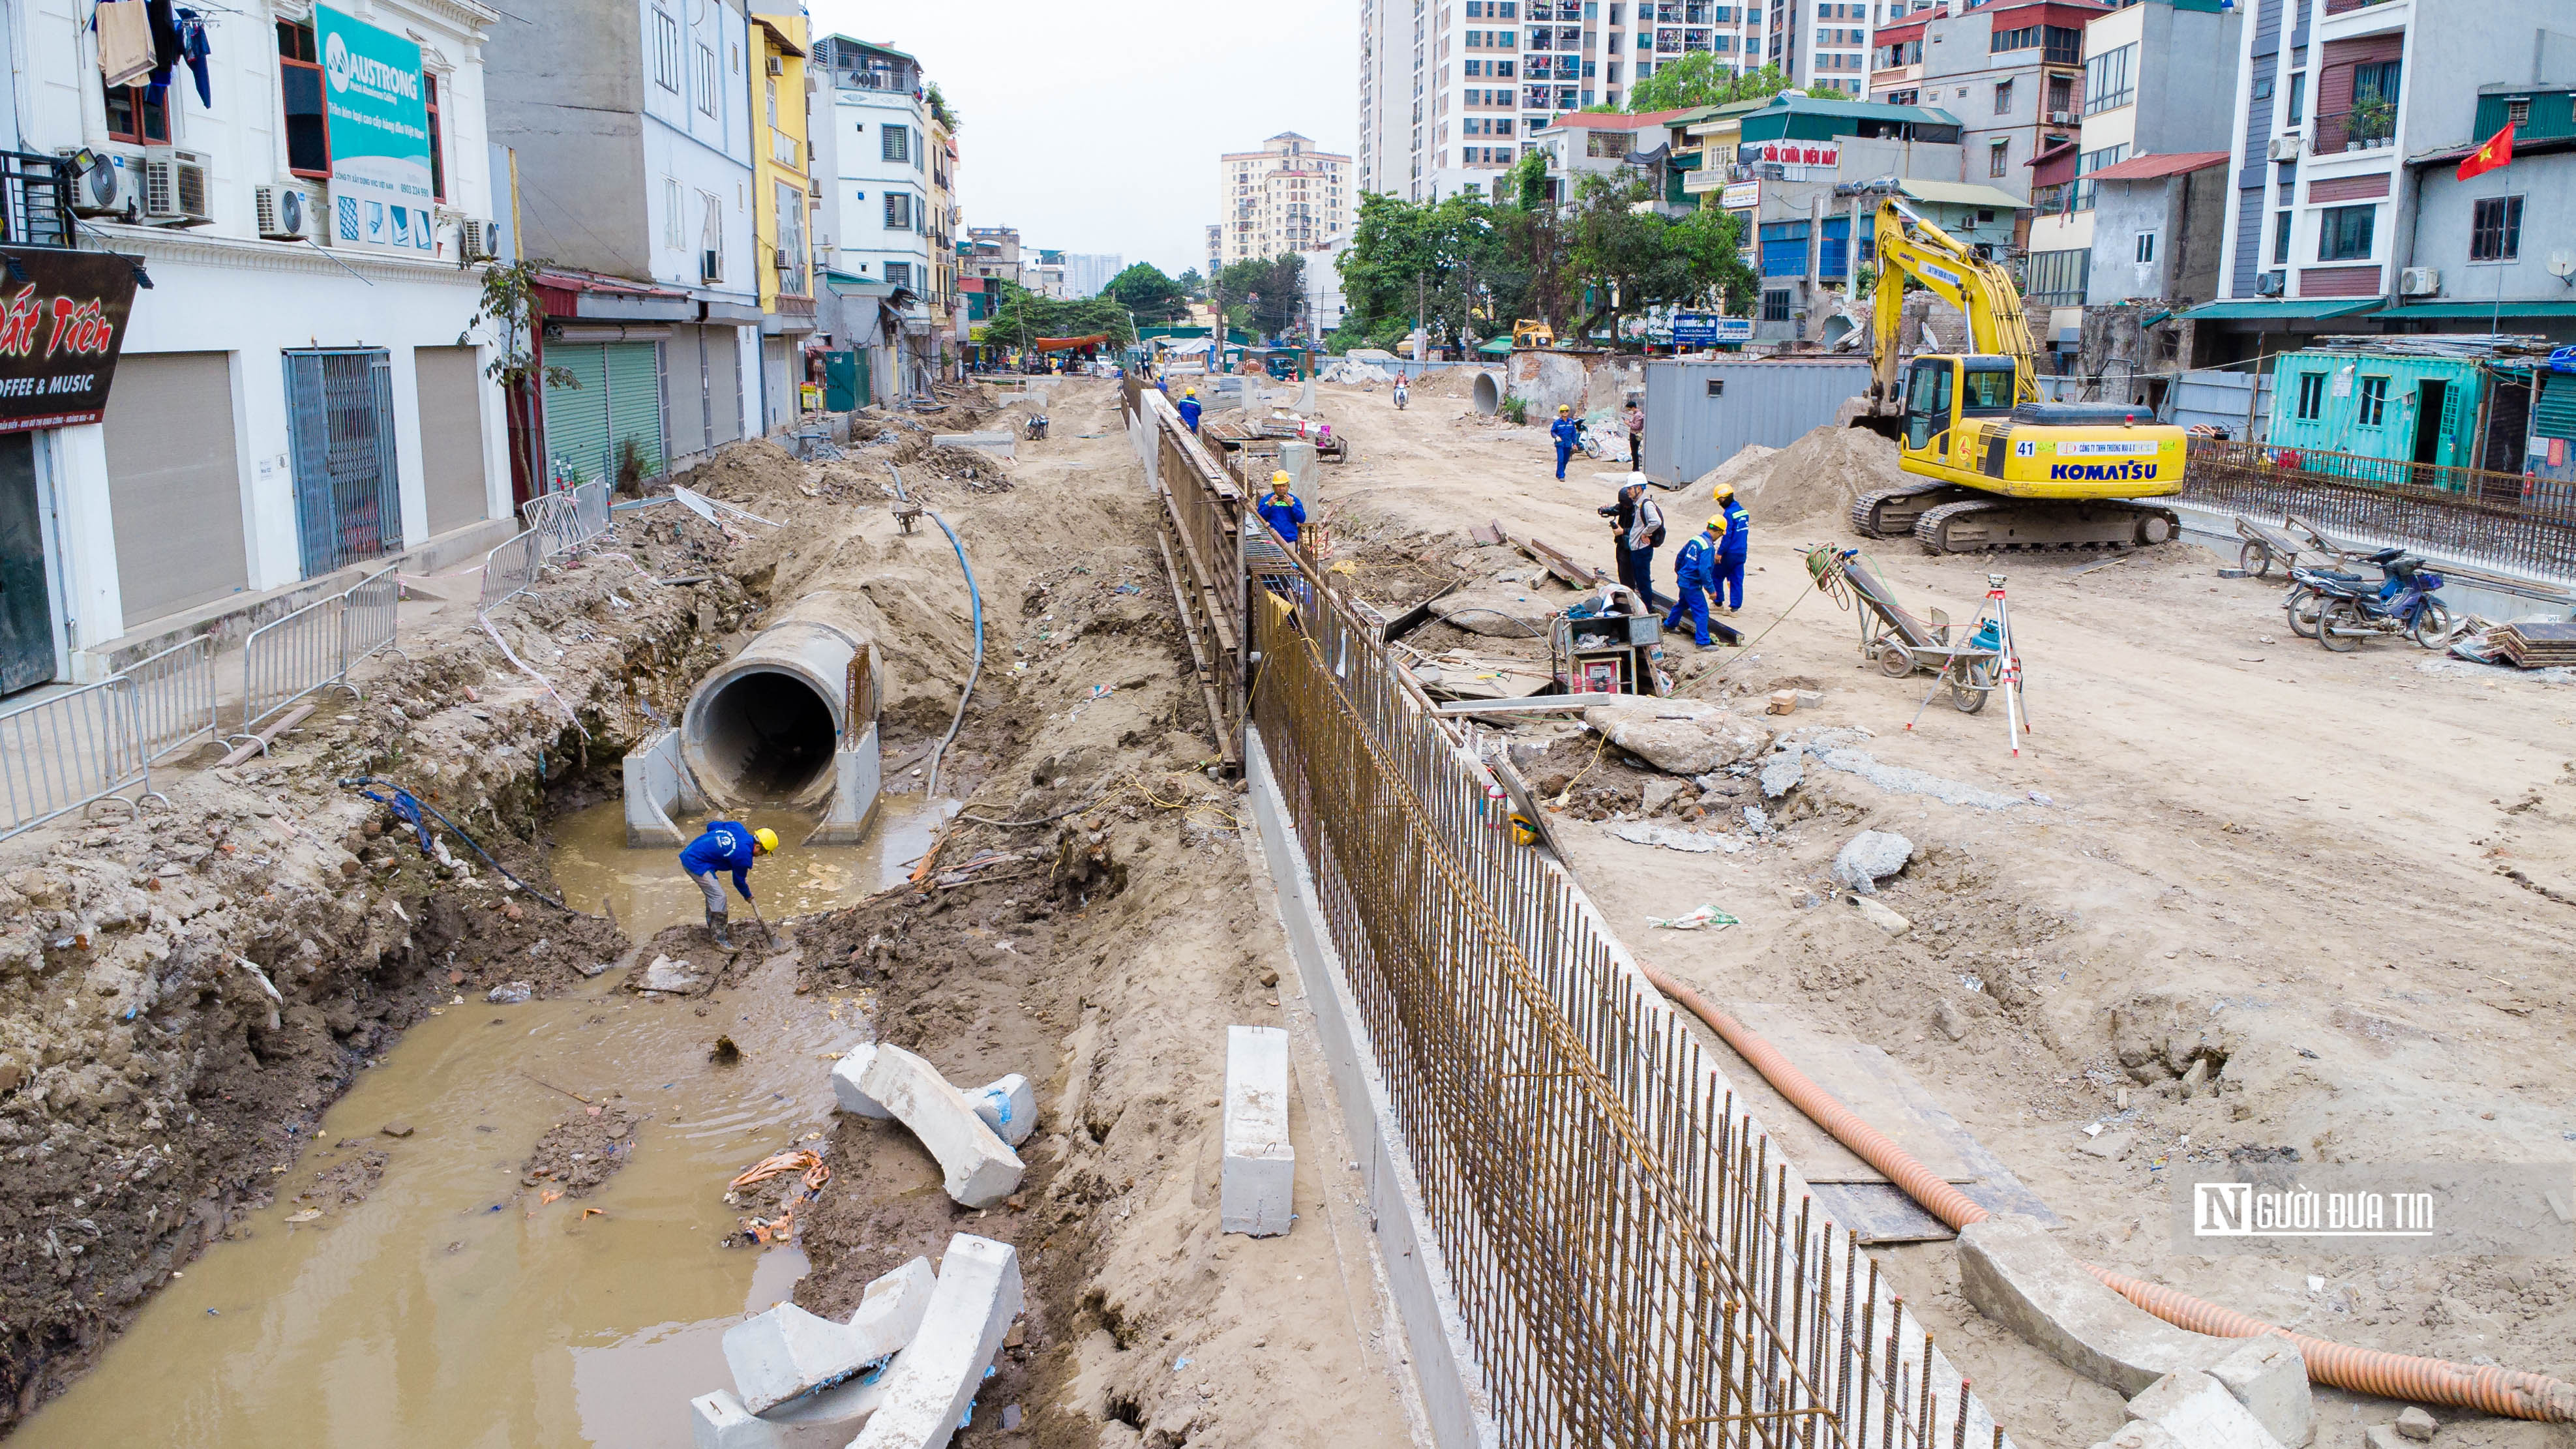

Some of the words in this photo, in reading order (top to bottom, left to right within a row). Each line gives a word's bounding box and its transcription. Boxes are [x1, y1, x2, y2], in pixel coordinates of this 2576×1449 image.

[350, 52, 417, 100] AUSTRONG
[363, 114, 372, 125] cao
[36, 379, 45, 395] &
[48, 374, 95, 394] MUSIC
[2018, 442, 2033, 455] 41
[2079, 443, 2089, 453] CÔNG
[2091, 444, 2095, 453] TY
[2096, 444, 2106, 453] TNHH
[2050, 460, 2158, 480] KOMATSU
